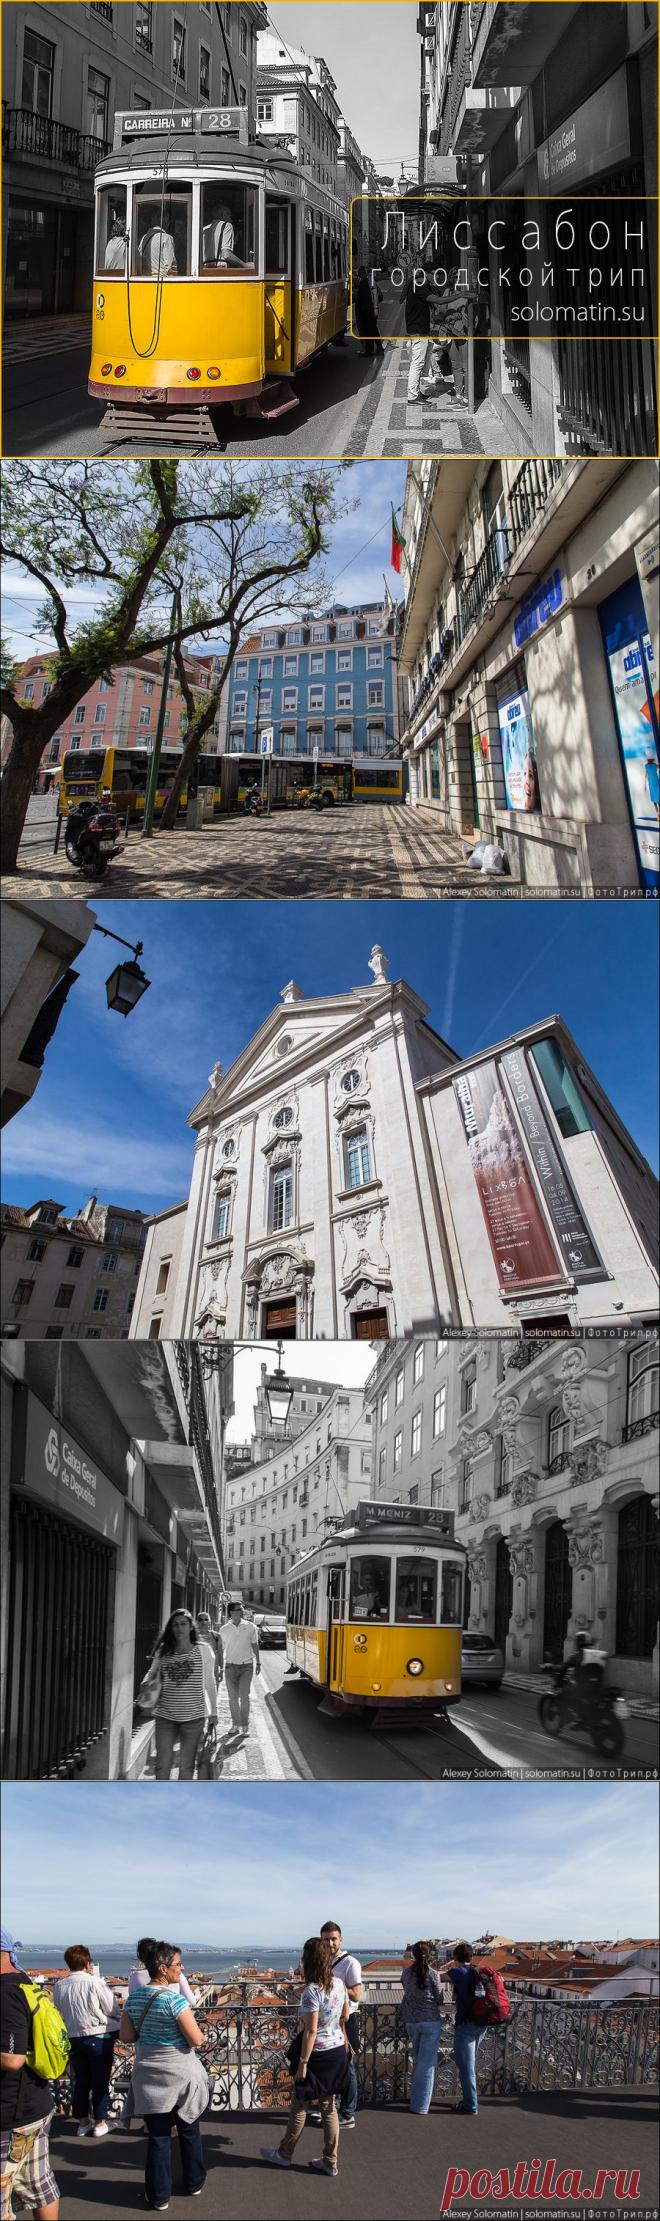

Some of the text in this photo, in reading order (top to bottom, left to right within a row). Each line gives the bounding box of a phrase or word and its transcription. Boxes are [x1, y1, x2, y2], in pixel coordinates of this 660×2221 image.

[124, 117, 176, 130] CARREIRA
[208, 113, 232, 128] 28
[506, 1052, 530, 1104] Borders
[523, 1104, 540, 1139] Beyond
[61, 1467, 70, 1487] de
[62, 1442, 97, 1490] Caixa Geral
[428, 1511, 445, 1523] 28
